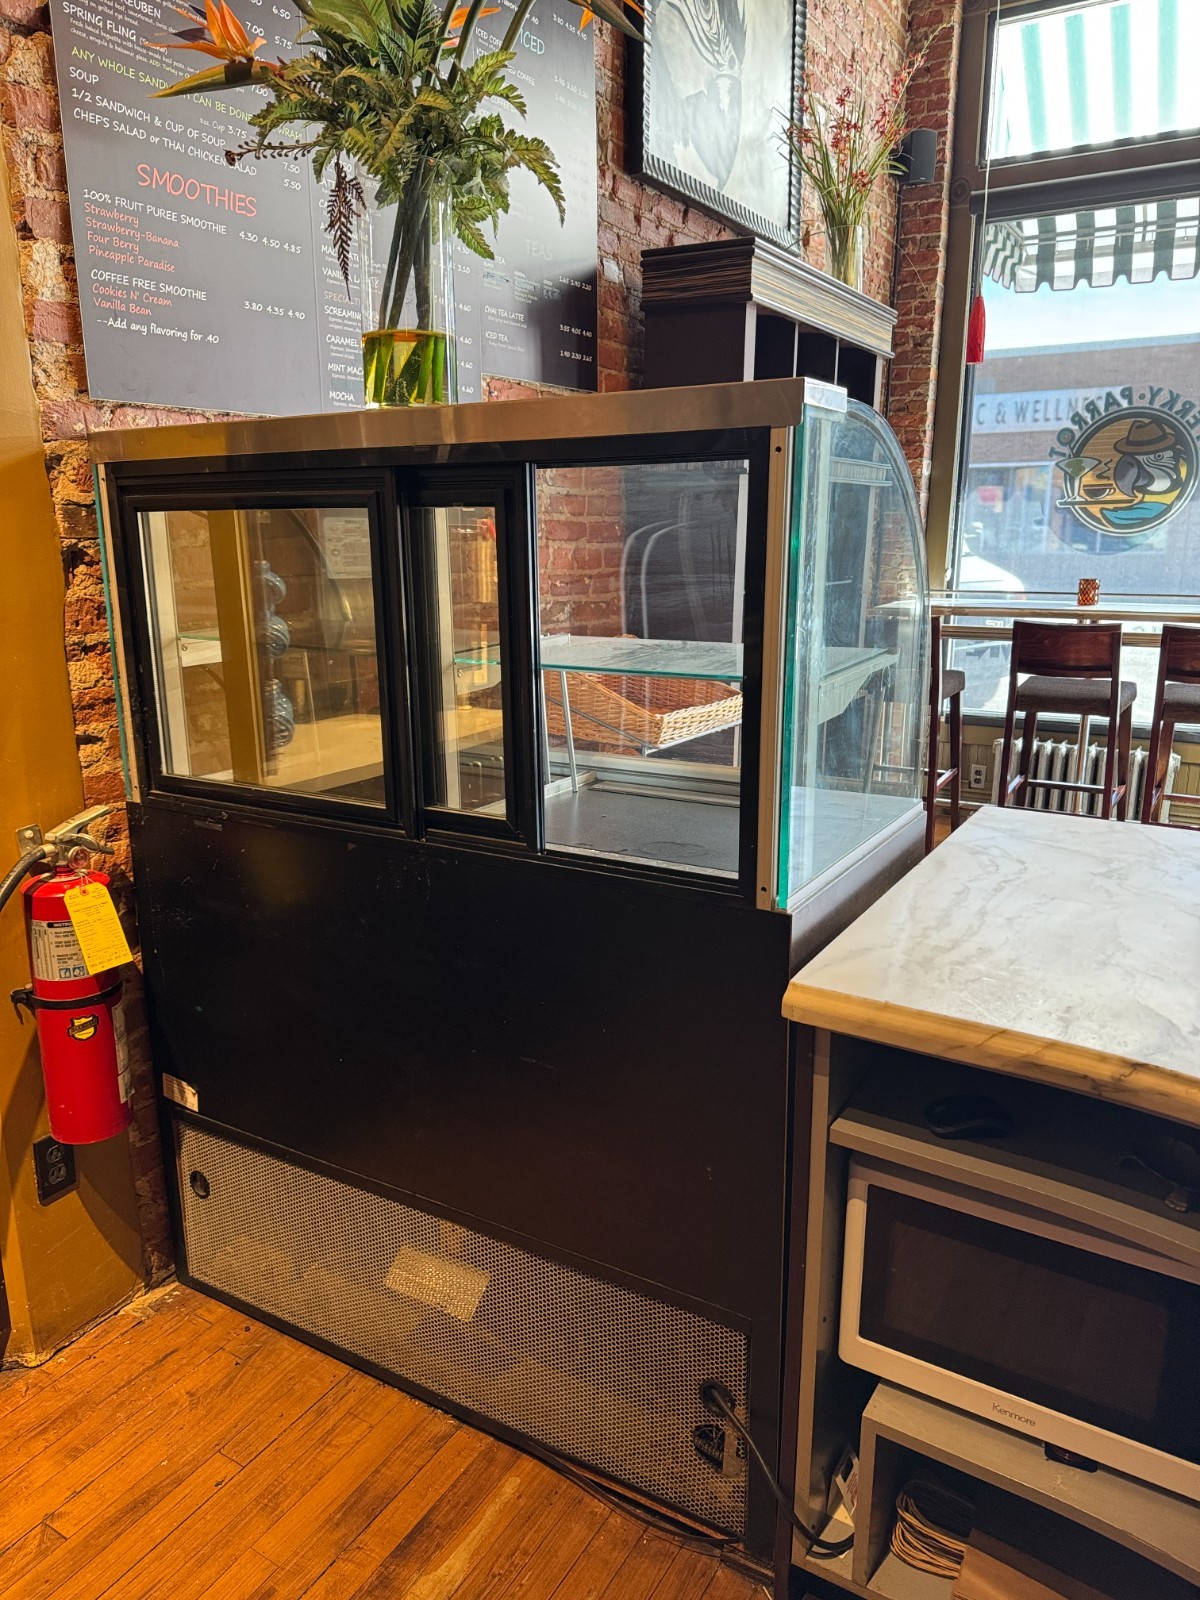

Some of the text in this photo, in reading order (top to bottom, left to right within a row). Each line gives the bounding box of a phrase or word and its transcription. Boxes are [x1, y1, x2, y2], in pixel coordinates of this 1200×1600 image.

[63, 2, 103, 28] SPRING
[107, 20, 136, 41] FLING
[273, 6, 290, 19] 6.50
[246, 21, 264, 36] 7.00
[275, 36, 292, 50] 5.75
[489, 35, 503, 46] COFF
[519, 28, 545, 54] ICED
[71, 46, 95, 63] ANY
[98, 56, 135, 79] WHOLE
[139, 72, 169, 89] SAND
[193, 94, 212, 108] CAN
[215, 102, 226, 114] BE
[516, 70, 536, 86] COFFEE
[69, 66, 99, 85] SOUP
[212, 121, 225, 133] Cup
[228, 125, 248, 139] 3.75
[71, 88, 226, 148] 1/2 SANDWICH & CUP OF SOUP
[113, 121, 147, 139] SALAD
[150, 136, 160, 144] or
[162, 137, 184, 153] THAI
[188, 146, 226, 167] CHICKEN
[282, 162, 300, 174] 7.50
[137, 163, 257, 217] SMOOTHIES
[283, 179, 301, 191] 5.50
[83, 189, 301, 254] 100% FRUIT PUREE SMOOTHIE 4.30 4.50 4.85
[84, 202, 139, 227] Strawberry
[85, 217, 179, 248] Strawberry-Banana
[87, 231, 139, 254] Four Berry
[88, 244, 176, 272] Pineapple Paradise
[524, 238, 552, 261] TEAS
[322, 267, 352, 282] VANILA
[91, 269, 305, 320] COFFEE FREE SMOOTHIE 3.80 4.35 4.90
[92, 282, 127, 299] Cookies
[142, 292, 173, 307] Cream
[94, 297, 152, 316] Vanilla Bean
[498, 309, 508, 318] TEA
[509, 311, 524, 322] LATTE
[130, 324, 147, 335] any
[150, 322, 188, 342] flavoring
[190, 329, 202, 341] for
[205, 334, 219, 344] .40
[326, 334, 359, 347] CARAMEL
[328, 363, 346, 372] MINT
[329, 391, 355, 401] MOCHA
[996, 402, 1007, 424] &
[992, 1402, 1036, 1426] Kenmore
